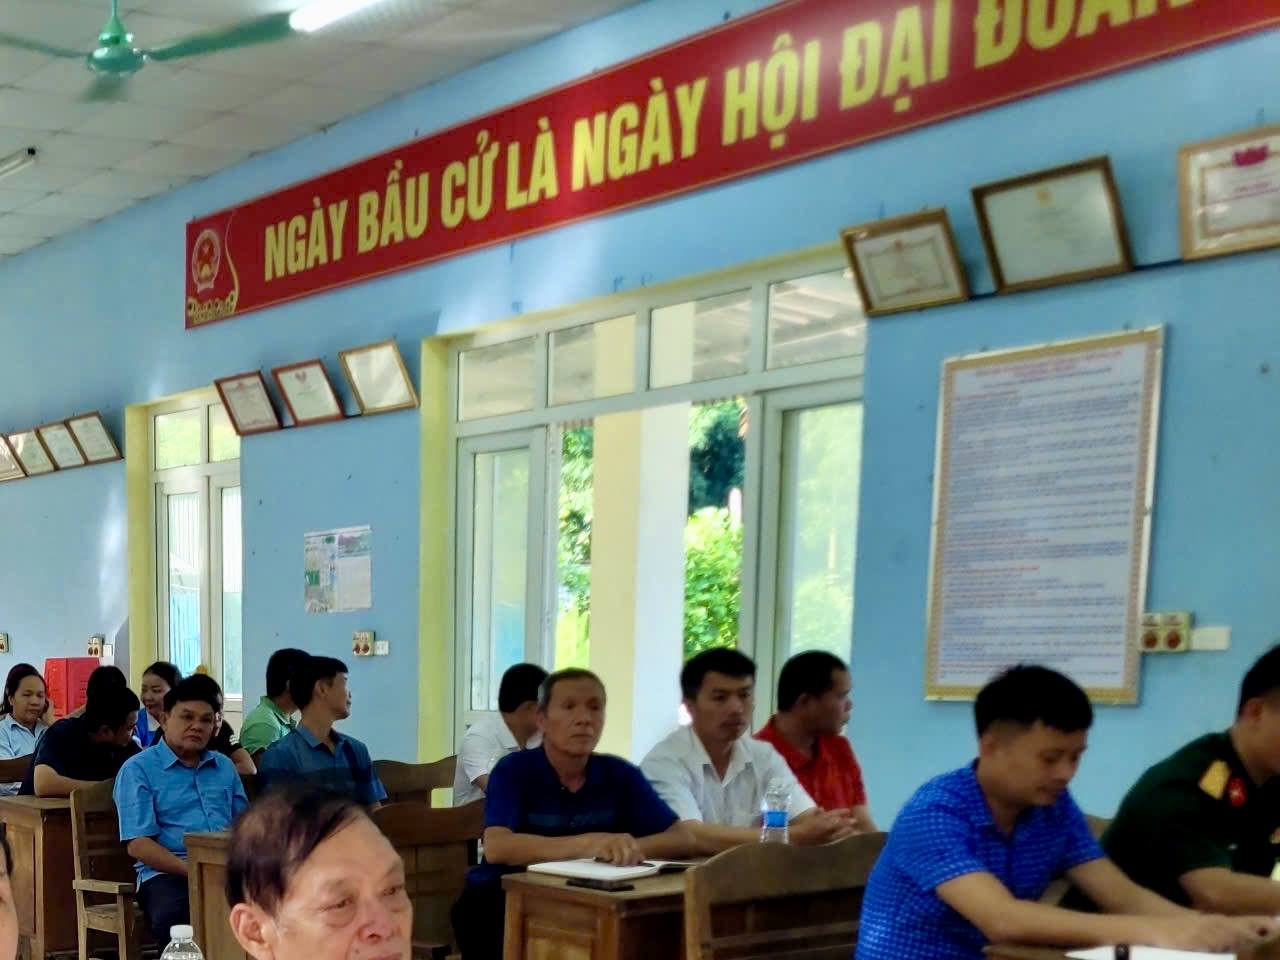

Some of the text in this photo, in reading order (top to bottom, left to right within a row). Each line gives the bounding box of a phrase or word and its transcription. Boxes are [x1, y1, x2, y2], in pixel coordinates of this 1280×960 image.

[264, 195, 349, 282] NGÀY
[357, 159, 430, 254] BẦU
[440, 129, 500, 229] CỬ
[505, 117, 559, 211] LÀ
[571, 76, 709, 192] NGÀY
[722, 32, 821, 149] HỘI
[839, 0, 951, 113] ĐẠI
